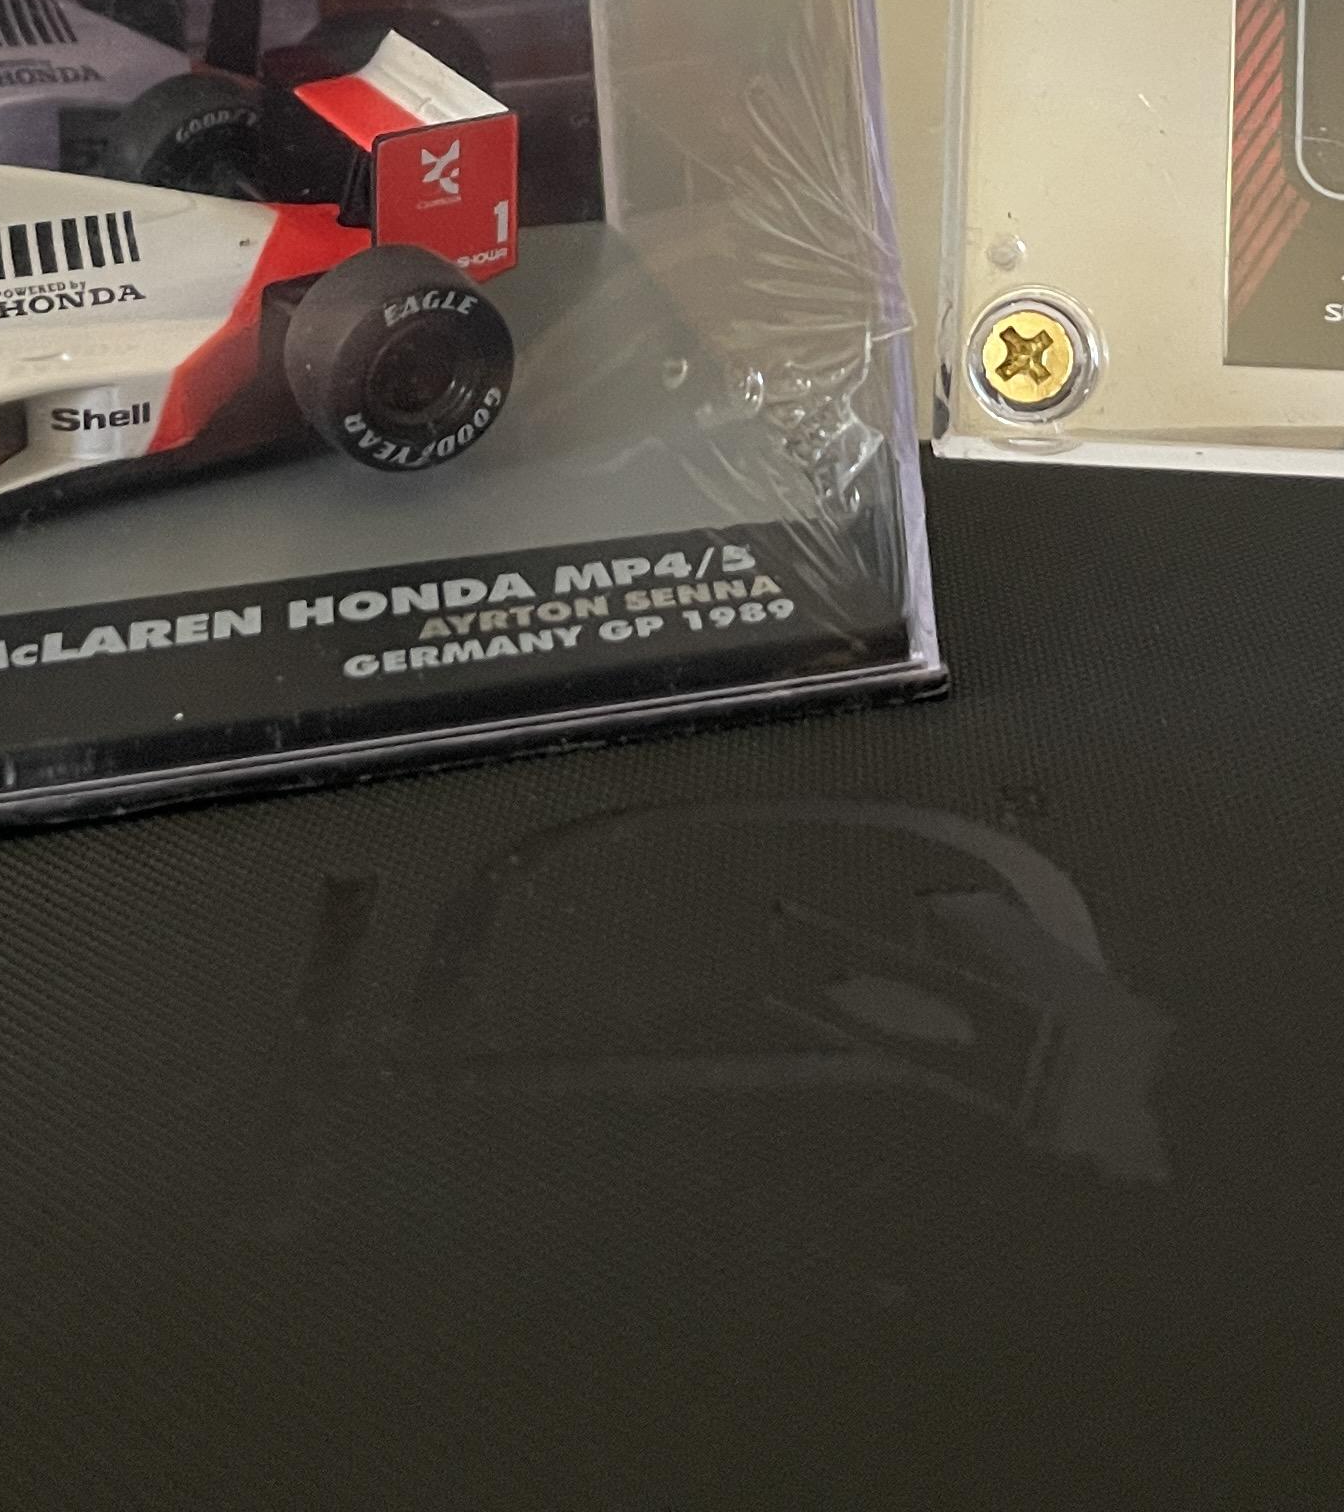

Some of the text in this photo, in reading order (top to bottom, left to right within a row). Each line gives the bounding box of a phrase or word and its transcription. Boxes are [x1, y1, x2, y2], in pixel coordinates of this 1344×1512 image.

[494, 200, 509, 243] 1
[69, 280, 86, 291] by
[384, 290, 479, 328] EAGLE
[51, 401, 151, 432] Shell
[343, 387, 502, 468] GOODYEAR
[288, 572, 536, 630] HONDA
[554, 543, 757, 594] MP4/5
[418, 573, 784, 641] AYRTON SENNA
[342, 599, 795, 678] GERMANY GP 1989
